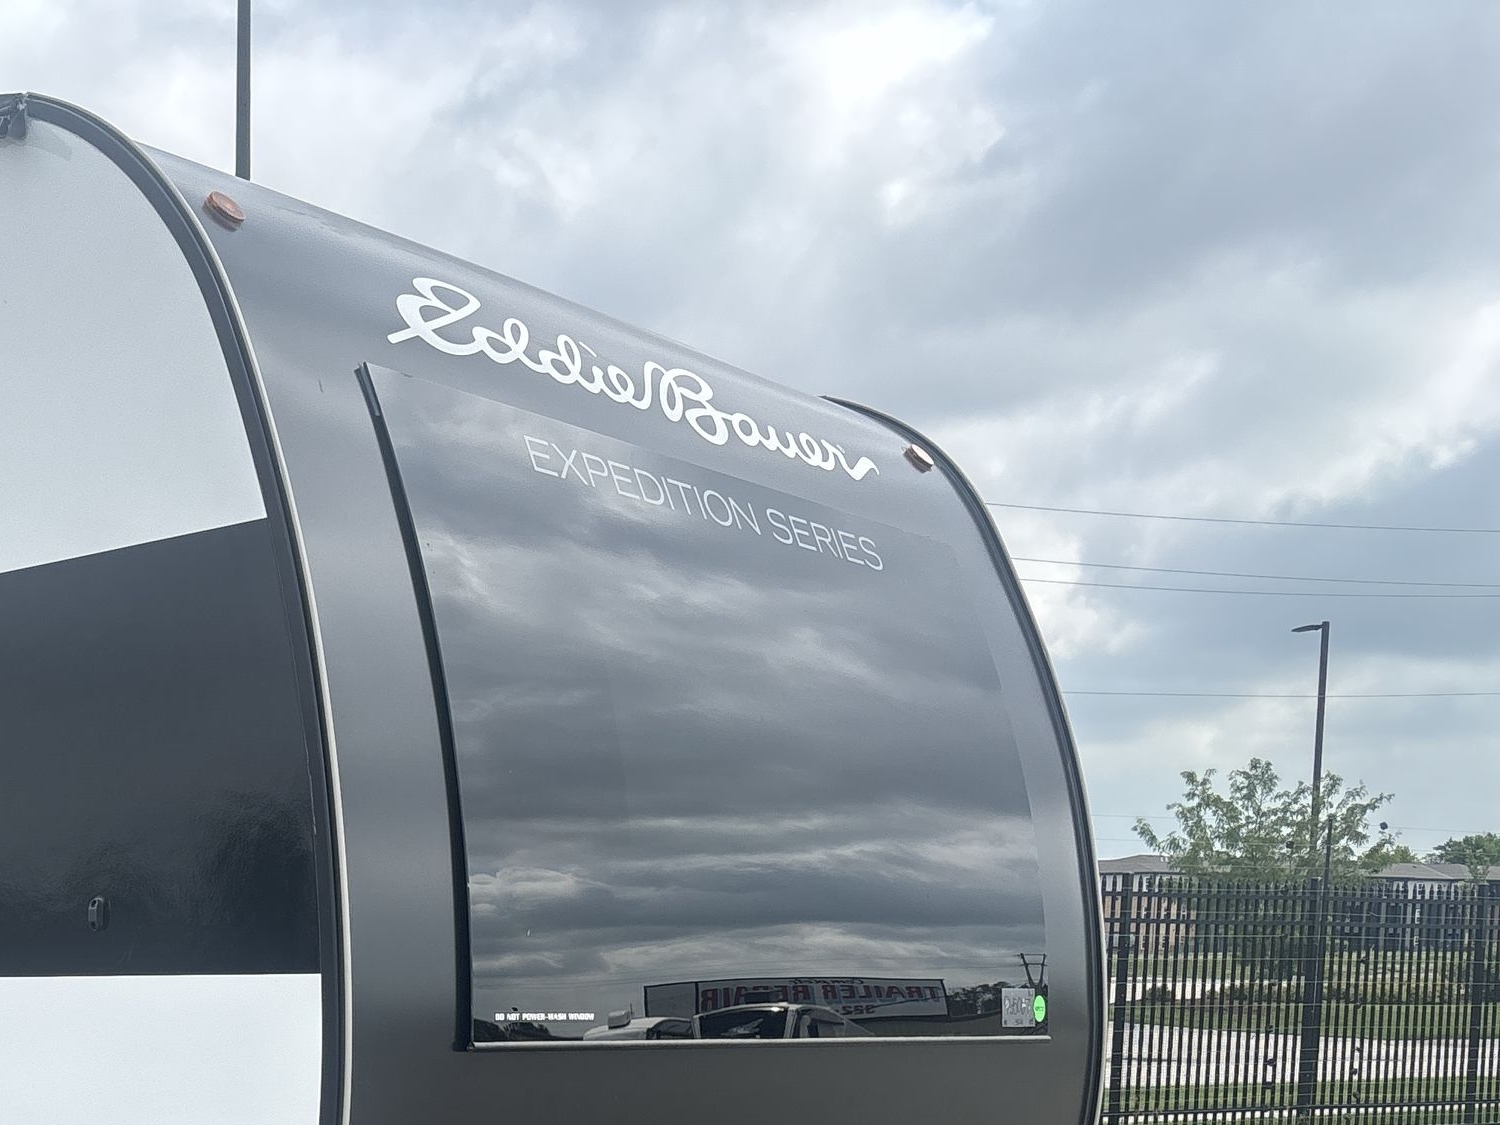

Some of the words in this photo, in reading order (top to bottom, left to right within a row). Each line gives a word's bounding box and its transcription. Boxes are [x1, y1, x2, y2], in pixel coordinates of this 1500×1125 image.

[388, 277, 650, 410] Eddie
[523, 434, 761, 536] EXPEDITION
[766, 508, 884, 571] SERIES
[494, 1013, 505, 1021] DO
[506, 1013, 520, 1021] NOT
[568, 1013, 595, 1021] WINDOW
